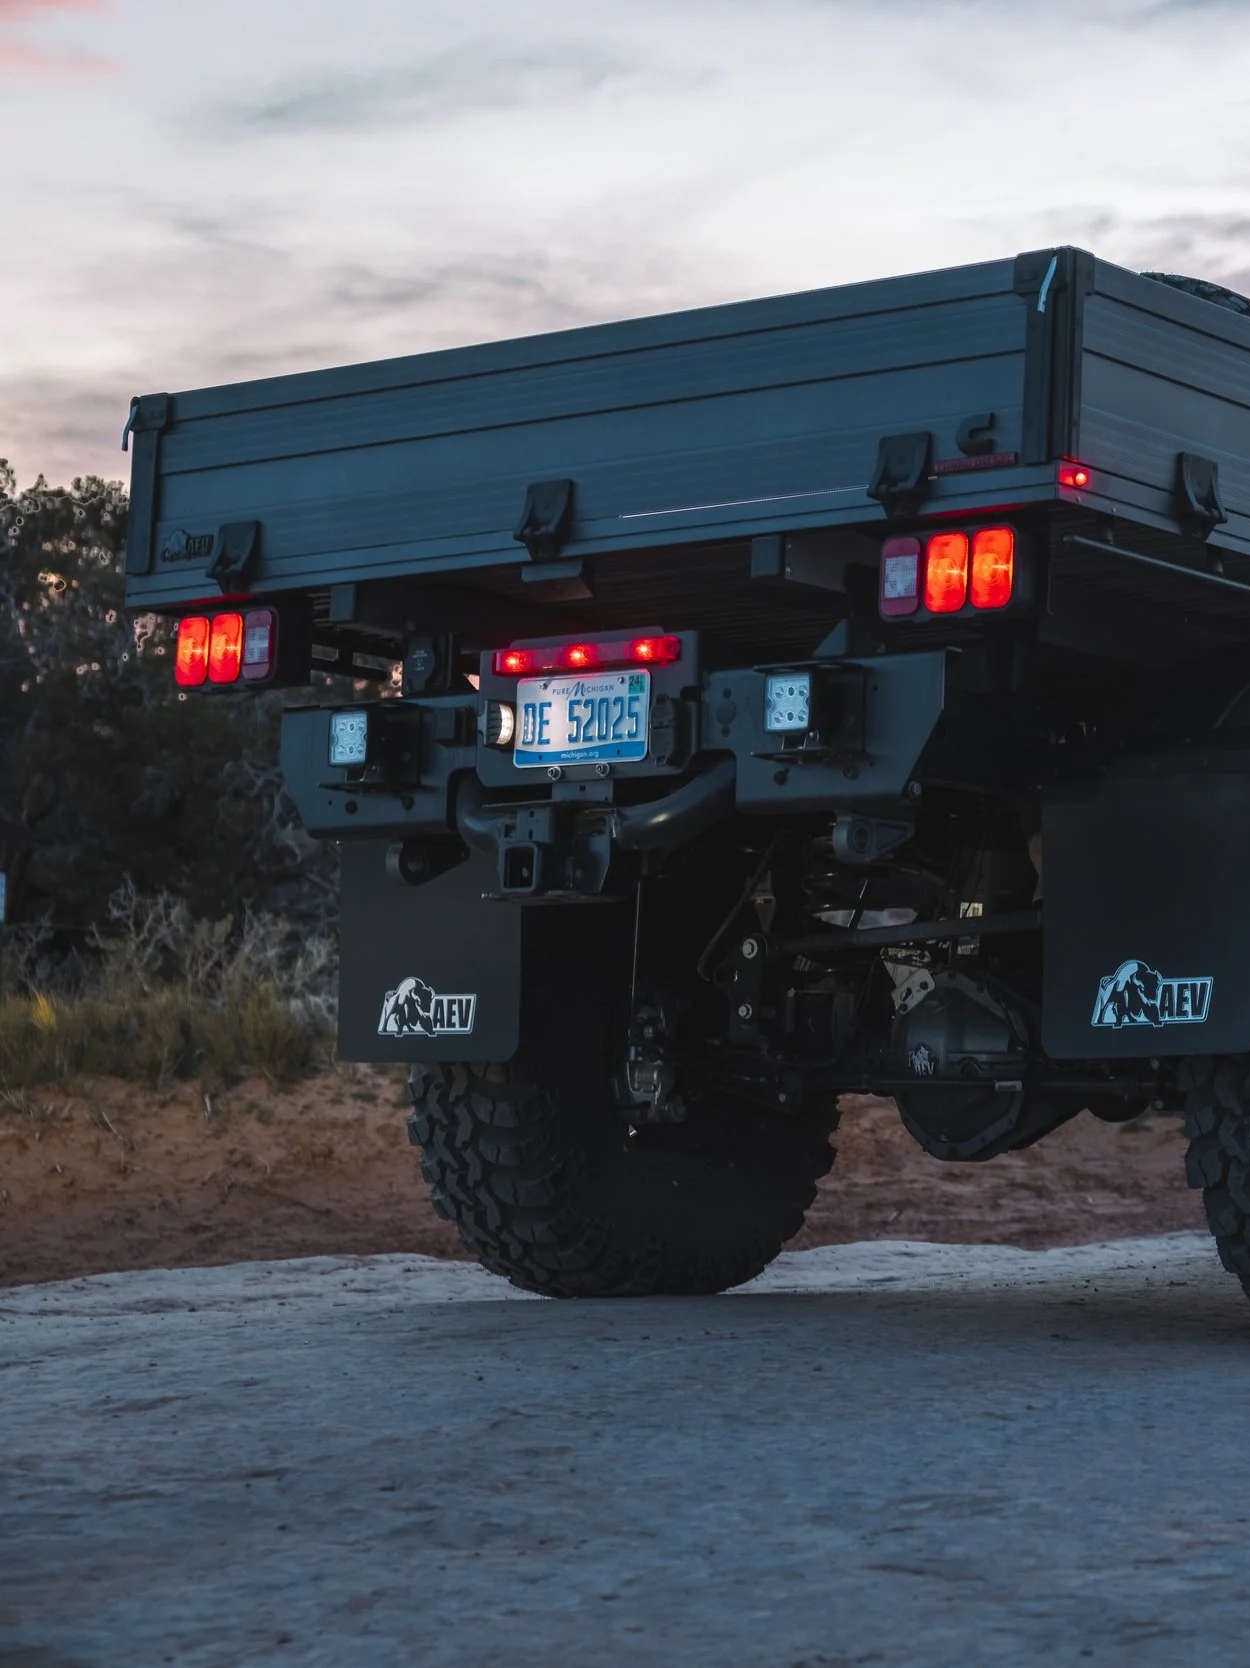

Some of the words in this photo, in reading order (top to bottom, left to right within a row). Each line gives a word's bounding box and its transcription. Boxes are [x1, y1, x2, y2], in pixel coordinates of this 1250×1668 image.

[552, 687, 570, 695] PURE
[628, 675, 640, 687] 24
[522, 702, 552, 745] DE
[567, 696, 640, 744] 52025
[560, 751, 600, 760] michigan.org
[1159, 981, 1209, 1020] AEV
[432, 998, 471, 1029] AEV
